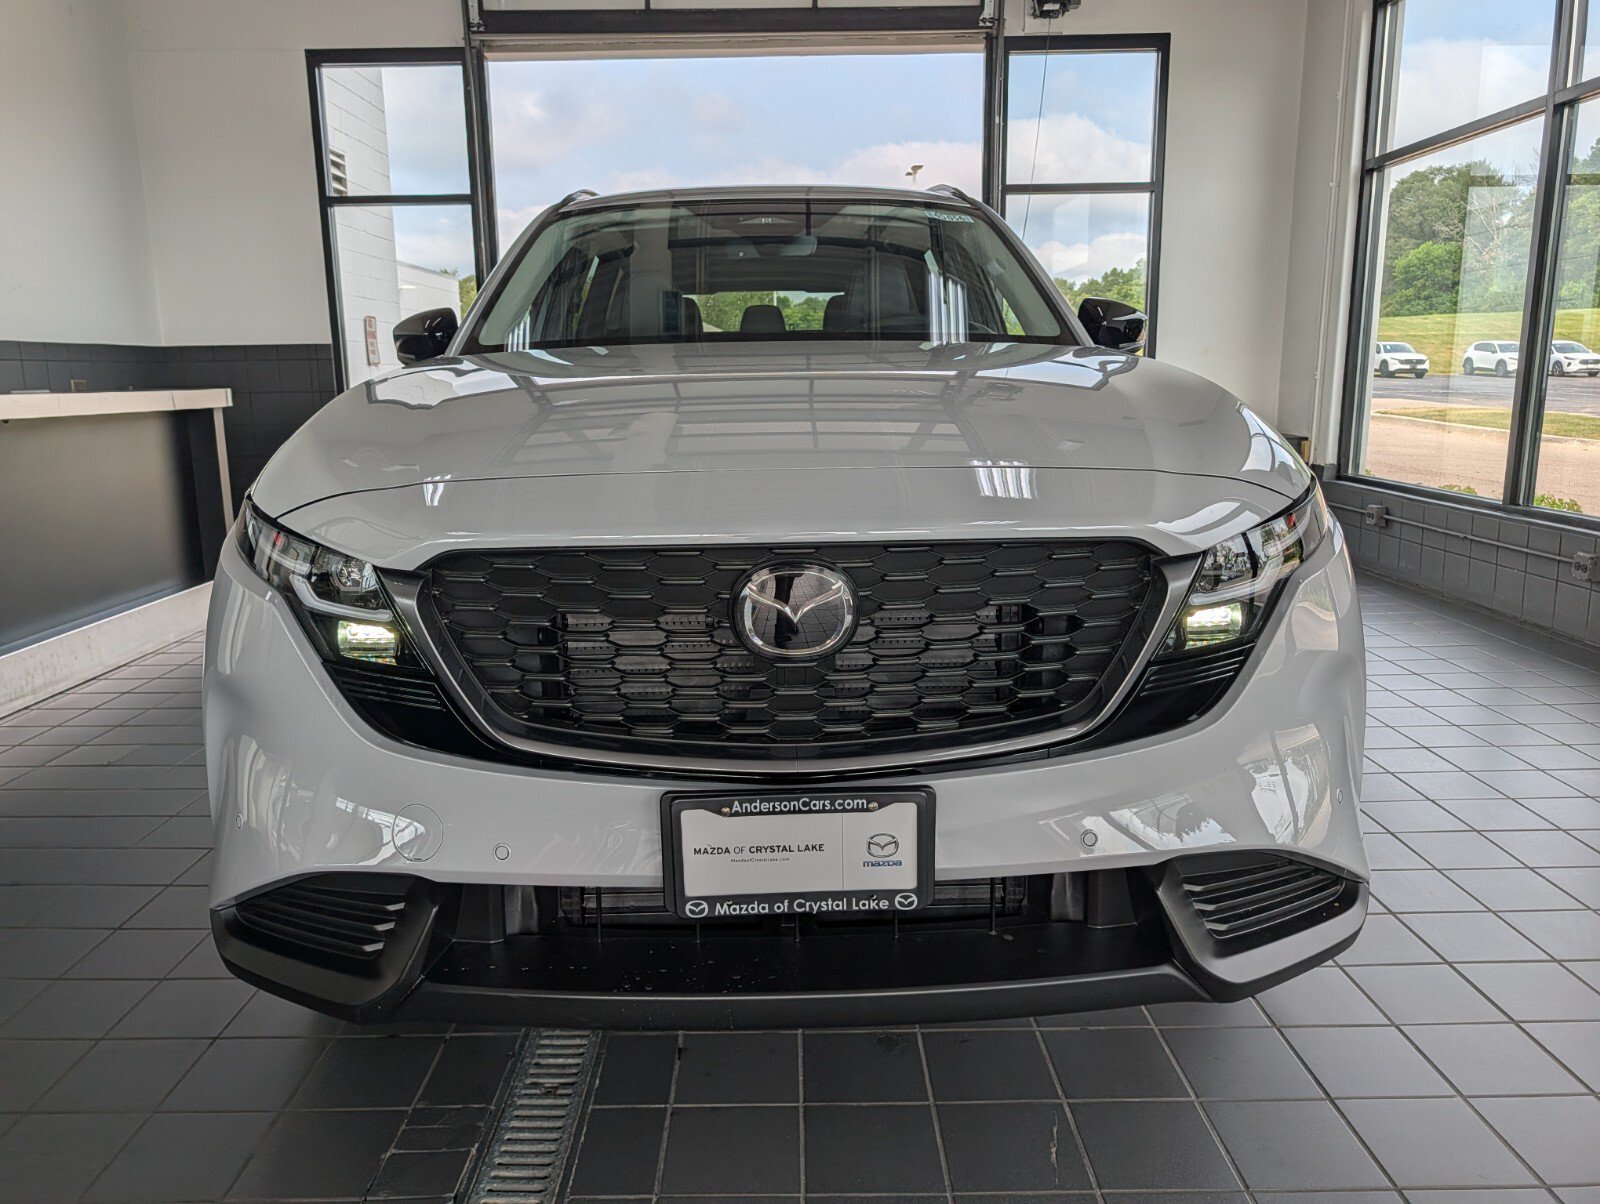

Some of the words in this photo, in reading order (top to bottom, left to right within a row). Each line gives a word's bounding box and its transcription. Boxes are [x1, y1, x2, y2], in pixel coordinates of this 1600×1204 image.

[731, 797, 867, 814] AndersonCars.com
[693, 847, 731, 856] MAZDA
[733, 846, 746, 855] OF
[748, 845, 795, 854] CRYSTAL
[797, 843, 825, 853] LAKE
[714, 901, 769, 915] Mazda
[773, 899, 789, 913] of
[793, 898, 847, 914] Crystal
[852, 897, 889, 911] Lake
